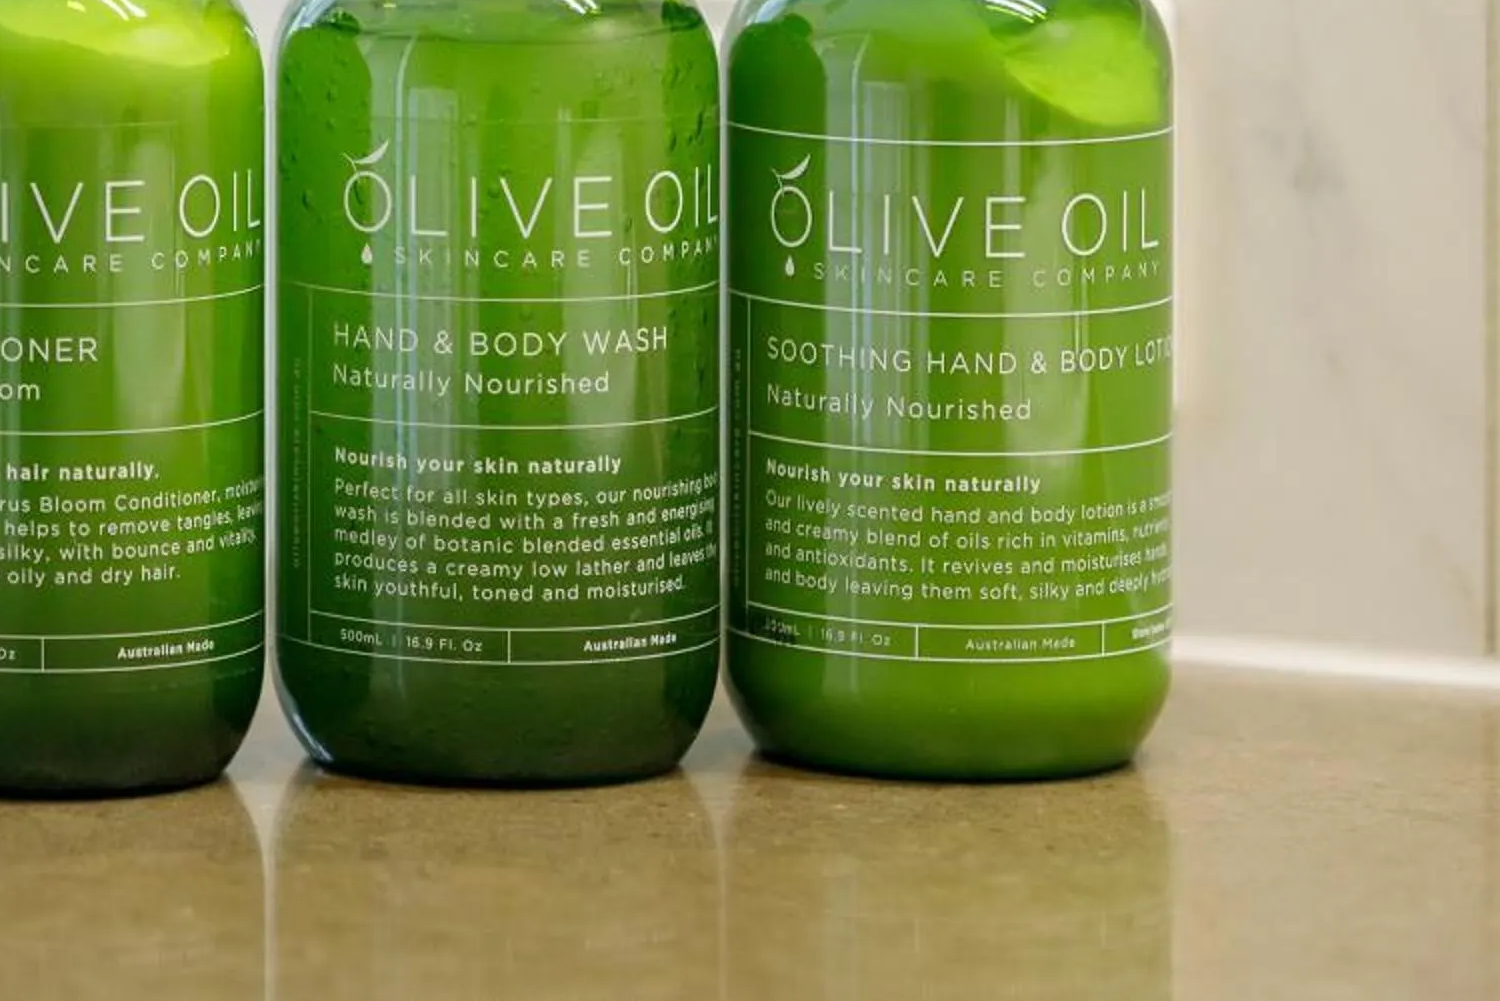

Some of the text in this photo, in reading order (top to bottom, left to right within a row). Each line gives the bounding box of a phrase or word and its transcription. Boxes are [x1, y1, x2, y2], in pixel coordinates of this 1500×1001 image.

[179, 168, 261, 239] OIL
[343, 163, 719, 240] OLIVE OIL
[771, 186, 1160, 259] OLIVE OIL
[394, 247, 592, 269] SKINCARE
[812, 259, 1160, 288] SKINCARE COMPANY
[333, 324, 668, 357] HAND & BODY WASH
[766, 336, 1128, 375] SOOTHING HAND & BODY
[332, 363, 610, 397] Naturally Nourished
[766, 383, 1032, 422] Naturally Nourished
[6, 462, 50, 481] hair
[58, 460, 160, 482] naturally.
[334, 447, 622, 475] Nourish your skin naturally
[766, 458, 1042, 494] Nourish your skin naturally
[39, 495, 106, 513] Bloom
[334, 477, 627, 509] Perfect for all skin types, our
[765, 488, 1124, 526] Our lively scented hand and body lotion
[4, 520, 60, 540] helps
[69, 520, 91, 538] to
[99, 518, 171, 537] remove
[334, 503, 657, 531] wash blended with fresh and
[59, 543, 103, 561] with
[111, 540, 181, 561] bounce
[187, 535, 214, 554] and
[334, 527, 399, 550] medley
[434, 534, 514, 555] botanic
[522, 535, 605, 555] blended
[611, 528, 681, 551] essential
[765, 518, 1033, 550] and creamy blend oils rich
[334, 551, 666, 581] produces creamy low lather and
[765, 542, 1142, 575] and antioxidants. revives and moisturises
[7, 566, 46, 588] oily
[54, 567, 93, 585] and
[100, 566, 134, 586] dry
[334, 572, 579, 602] skin youthful, toned and
[765, 567, 1106, 601] and body leaving them silky and
[117, 638, 216, 660] Australian Made
[339, 628, 383, 646] 500mL
[405, 634, 433, 650] 16.9
[462, 638, 483, 653] Oz
[583, 631, 678, 653] Australian Made
[965, 635, 1076, 652] Australian Made
